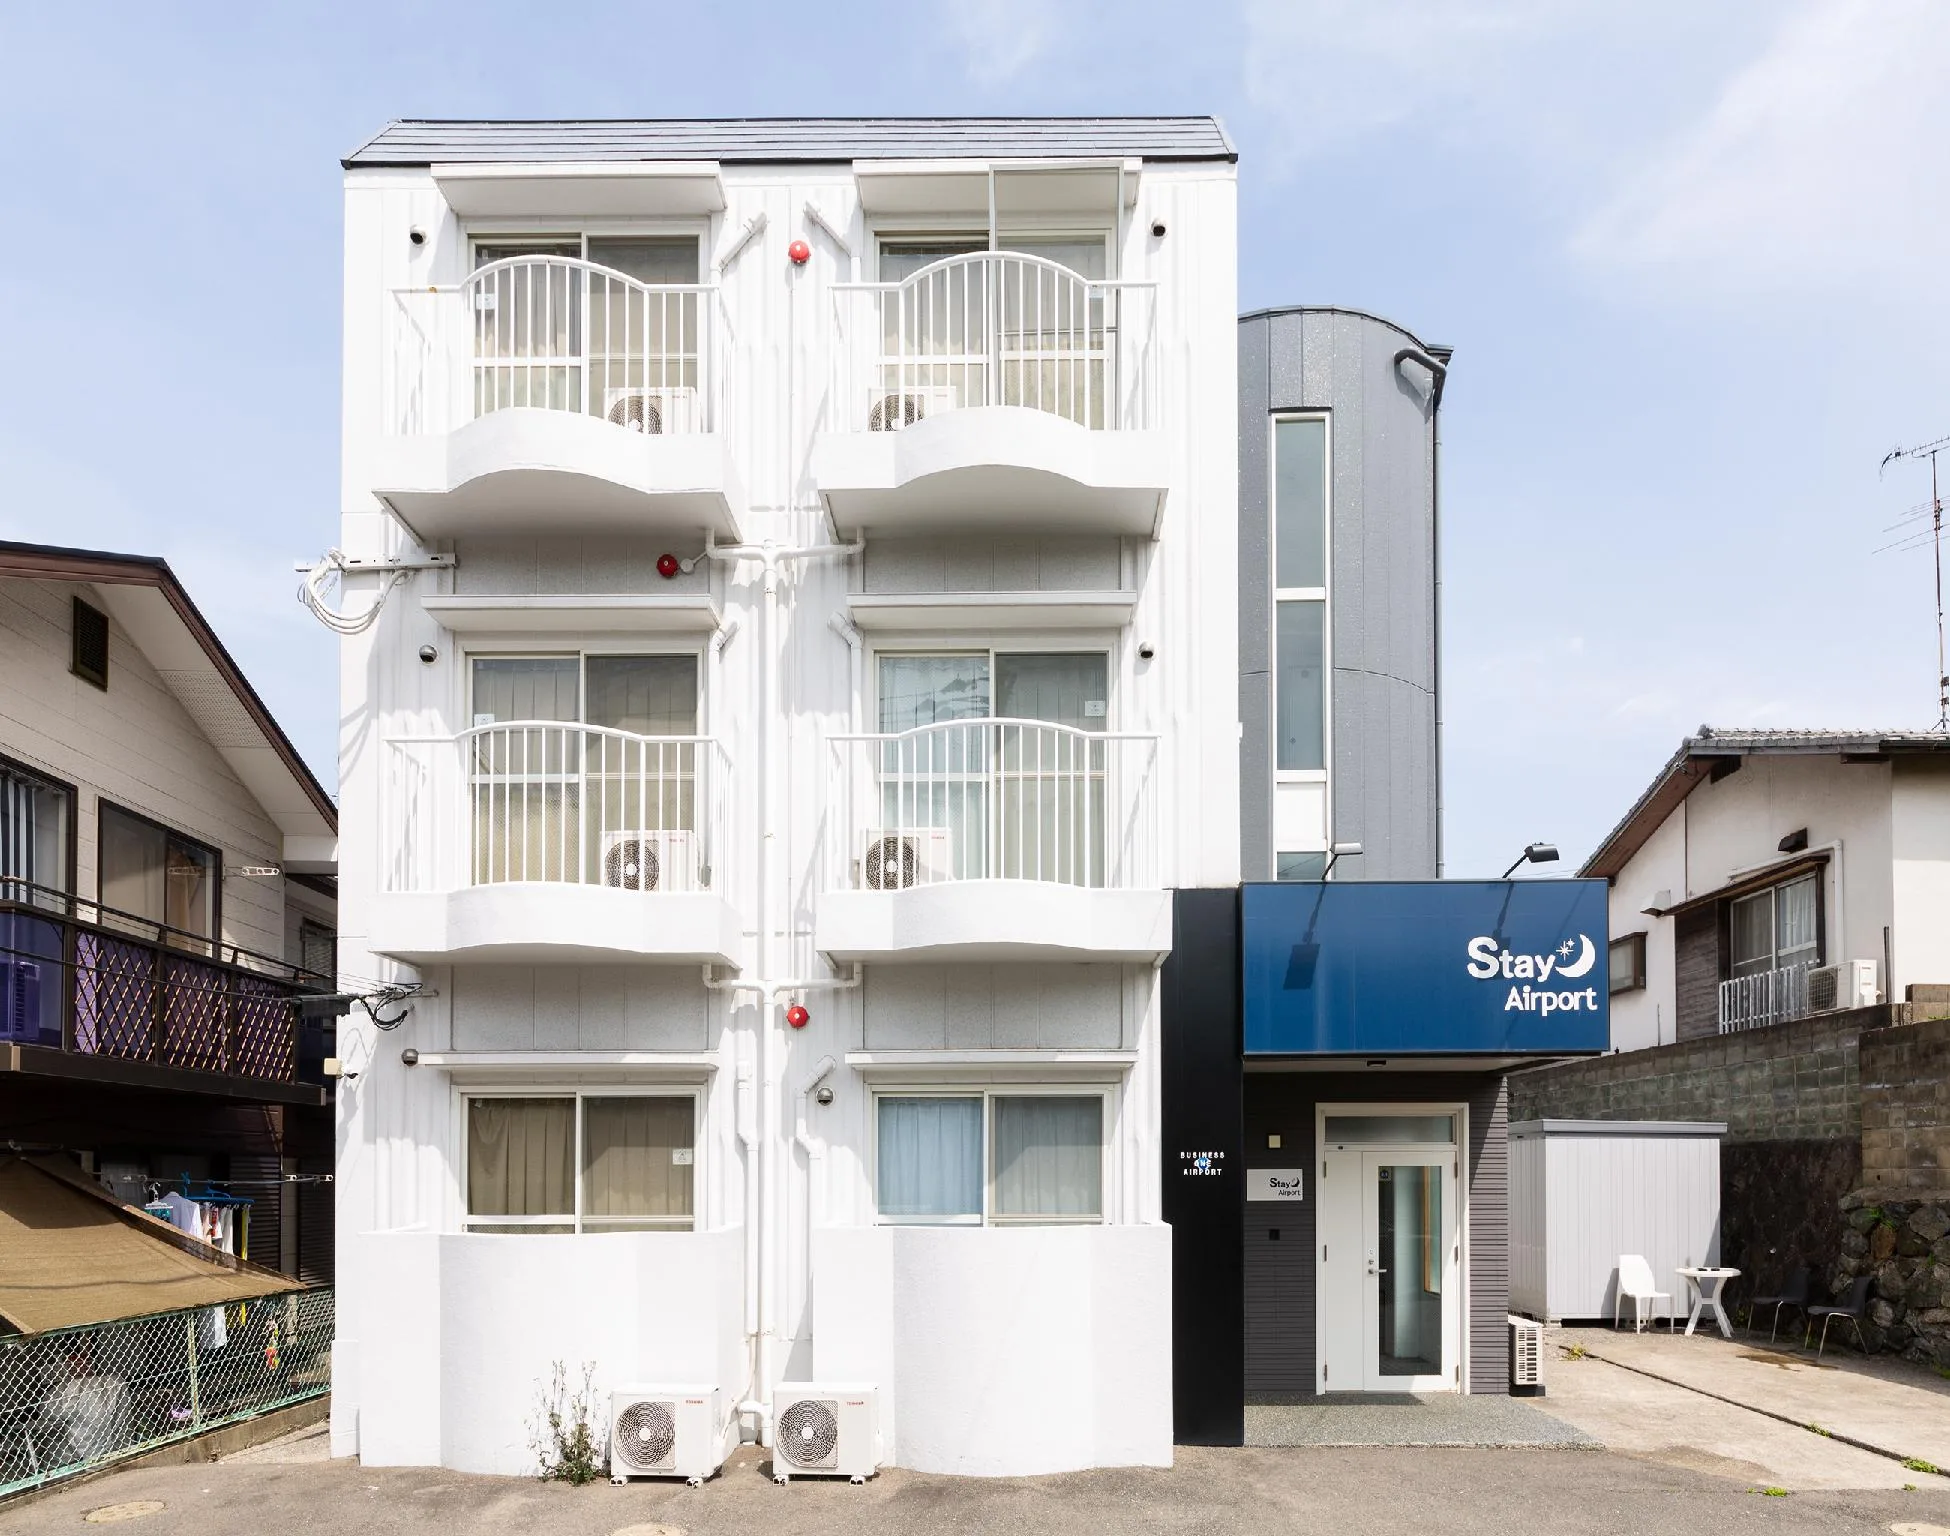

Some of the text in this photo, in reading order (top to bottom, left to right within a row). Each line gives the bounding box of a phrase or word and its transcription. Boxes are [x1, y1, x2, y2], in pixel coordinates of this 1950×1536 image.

[1467, 936, 1556, 982] Stay
[1504, 985, 1598, 1017] Airport
[1180, 1151, 1225, 1159] BUSINESS
[1183, 1168, 1222, 1176] AIRPORT
[1269, 1177, 1291, 1189] Stay
[1278, 1189, 1301, 1197] Airport
